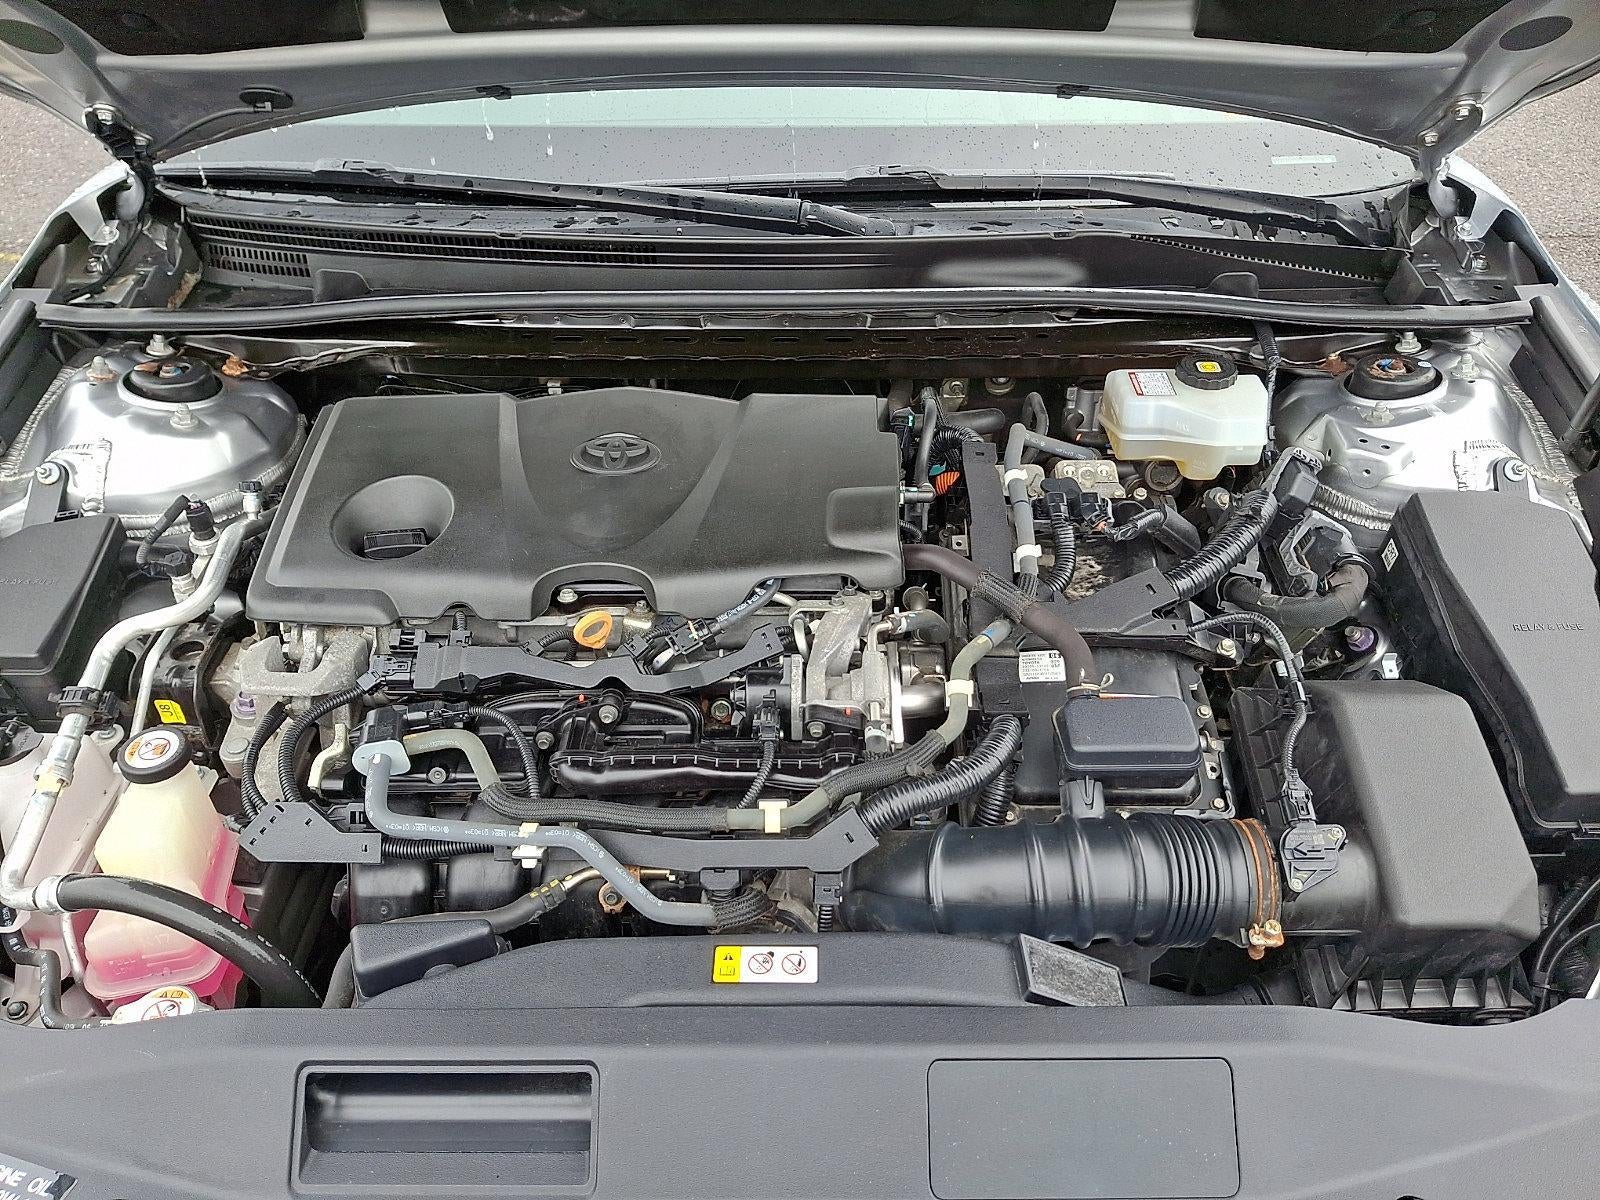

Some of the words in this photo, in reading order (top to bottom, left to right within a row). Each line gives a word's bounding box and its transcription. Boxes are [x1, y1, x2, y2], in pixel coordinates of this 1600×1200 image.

[1512, 623, 1546, 632] RELAY
[1556, 622, 1585, 631] FUSE
[159, 704, 174, 717] J8
[27, 1177, 53, 1197] OIL
